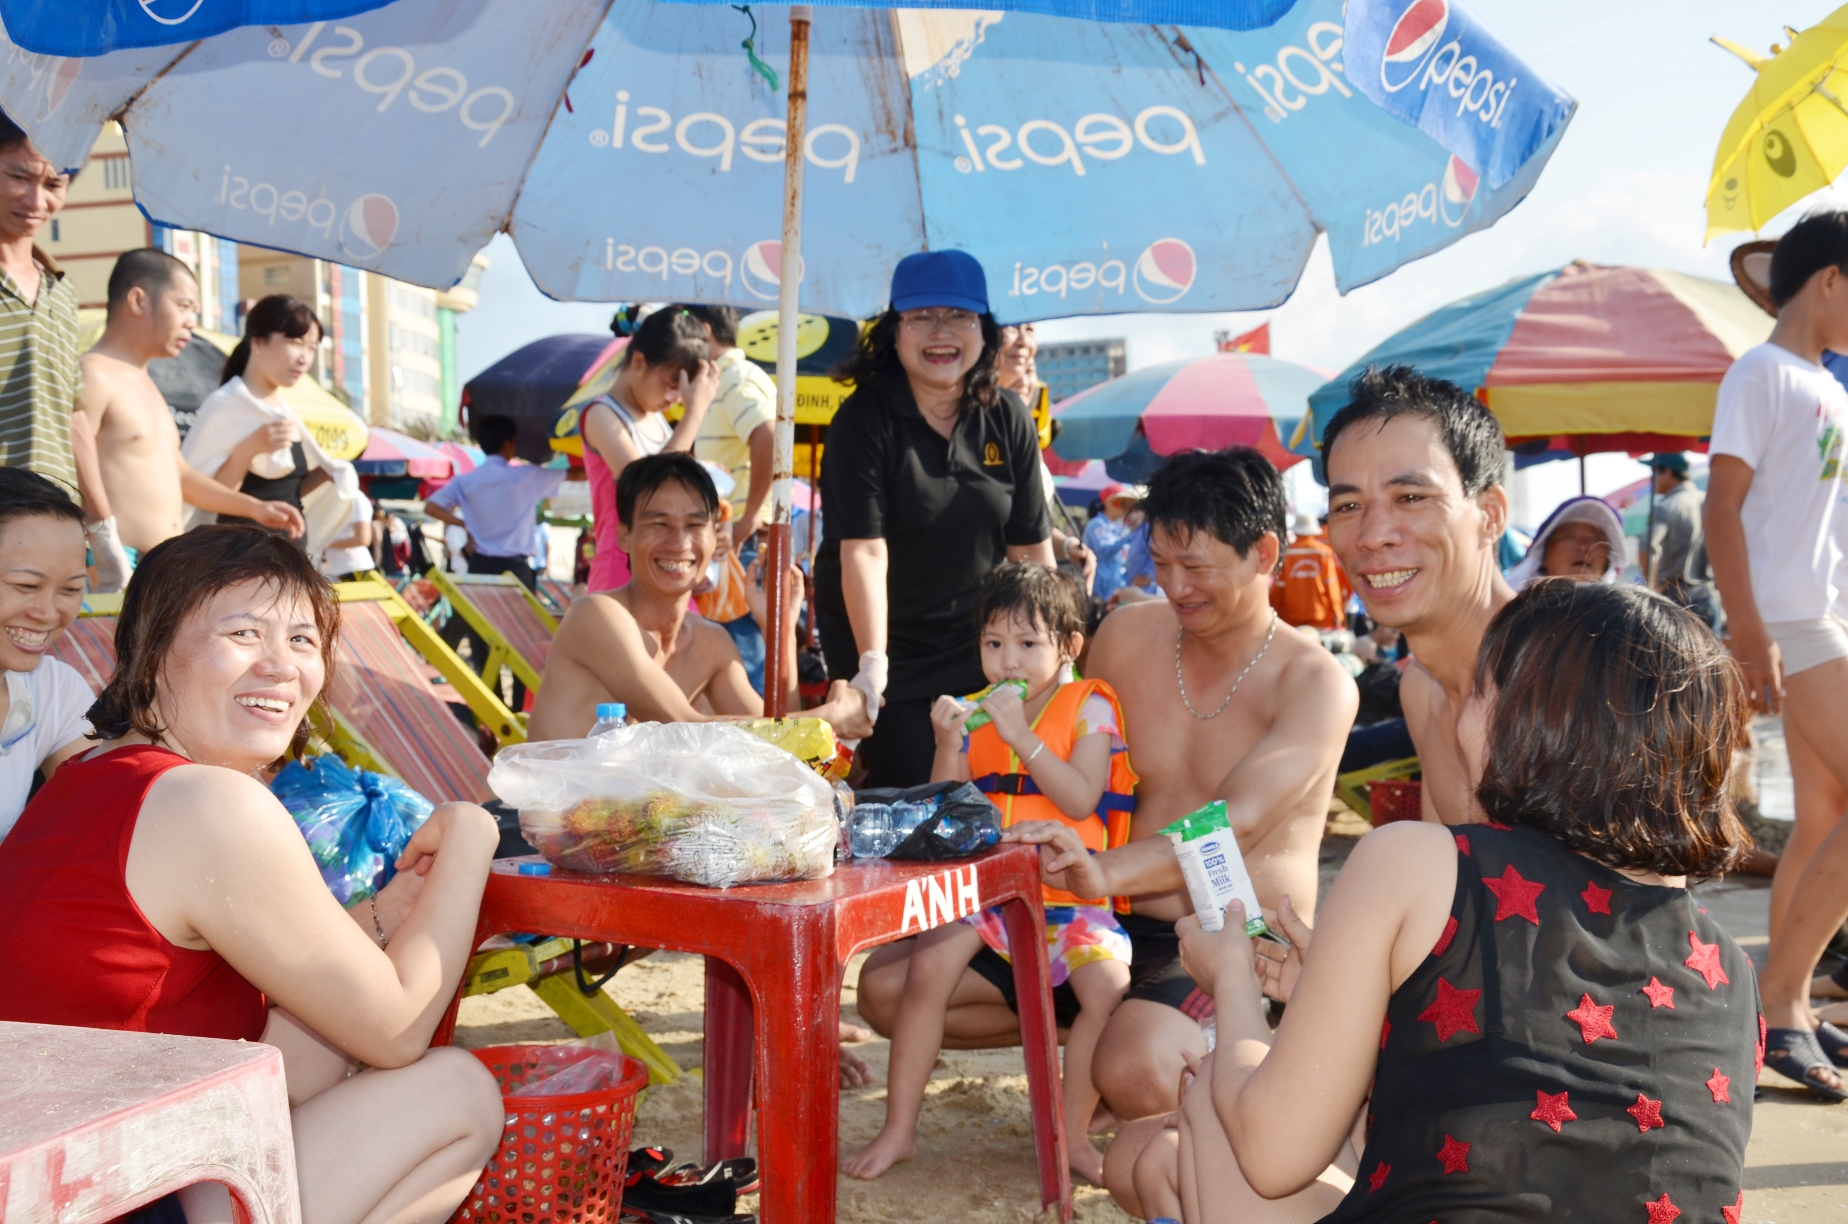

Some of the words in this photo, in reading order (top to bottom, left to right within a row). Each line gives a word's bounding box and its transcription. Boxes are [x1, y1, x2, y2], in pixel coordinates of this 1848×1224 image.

[1419, 40, 1517, 128] pepsi
[1204, 855, 1225, 868] 100%
[1208, 864, 1228, 878] Fresh
[1211, 874, 1231, 888] Milk
